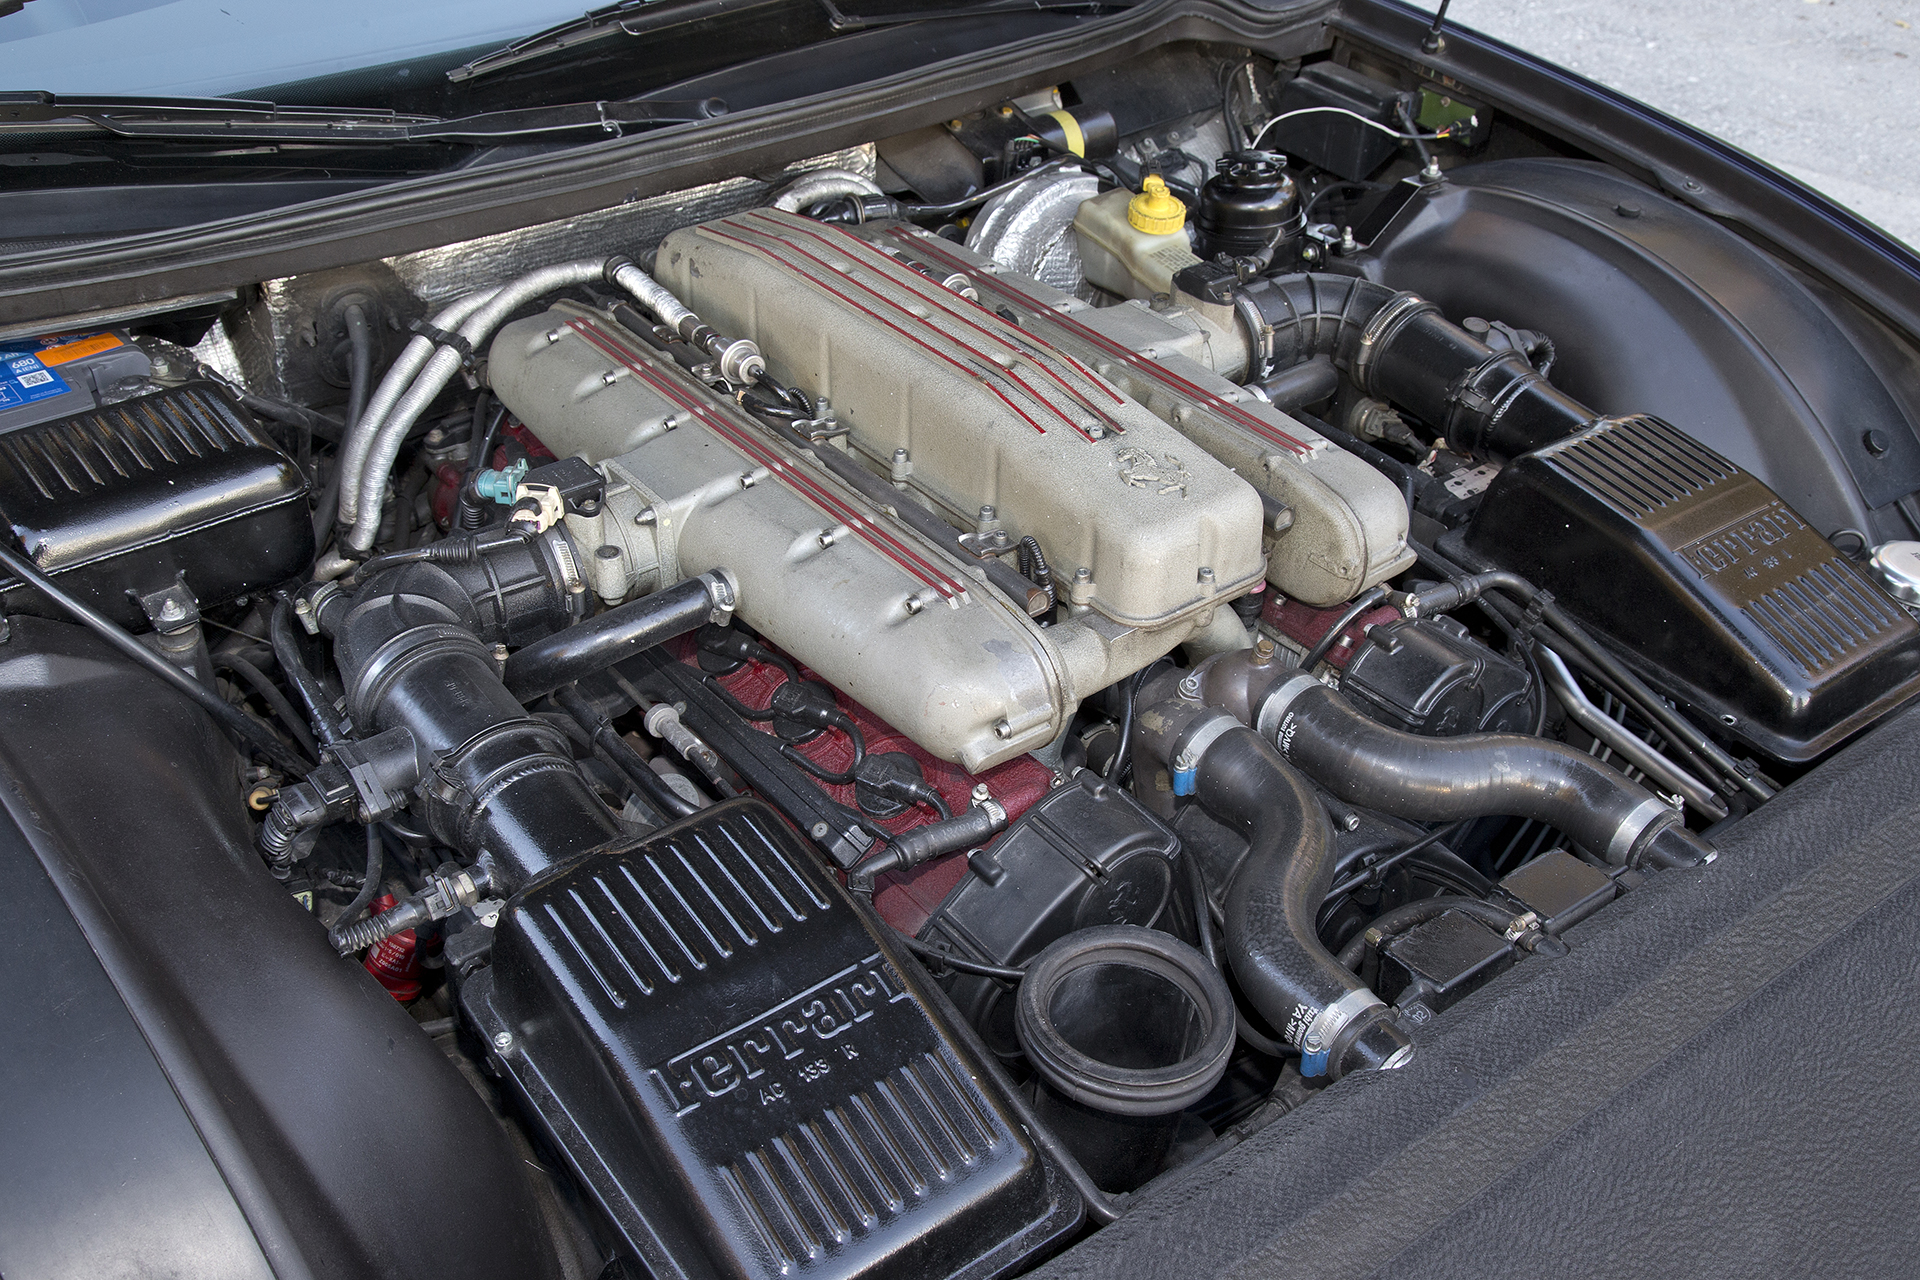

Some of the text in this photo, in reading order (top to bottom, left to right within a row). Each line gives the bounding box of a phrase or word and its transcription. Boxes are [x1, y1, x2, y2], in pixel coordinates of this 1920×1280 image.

[12, 358, 35, 369] 680
[1672, 499, 1810, 580] Ferrari
[649, 952, 908, 1118] Ferrari
[758, 1082, 786, 1106] AC
[841, 1044, 860, 1061] R
